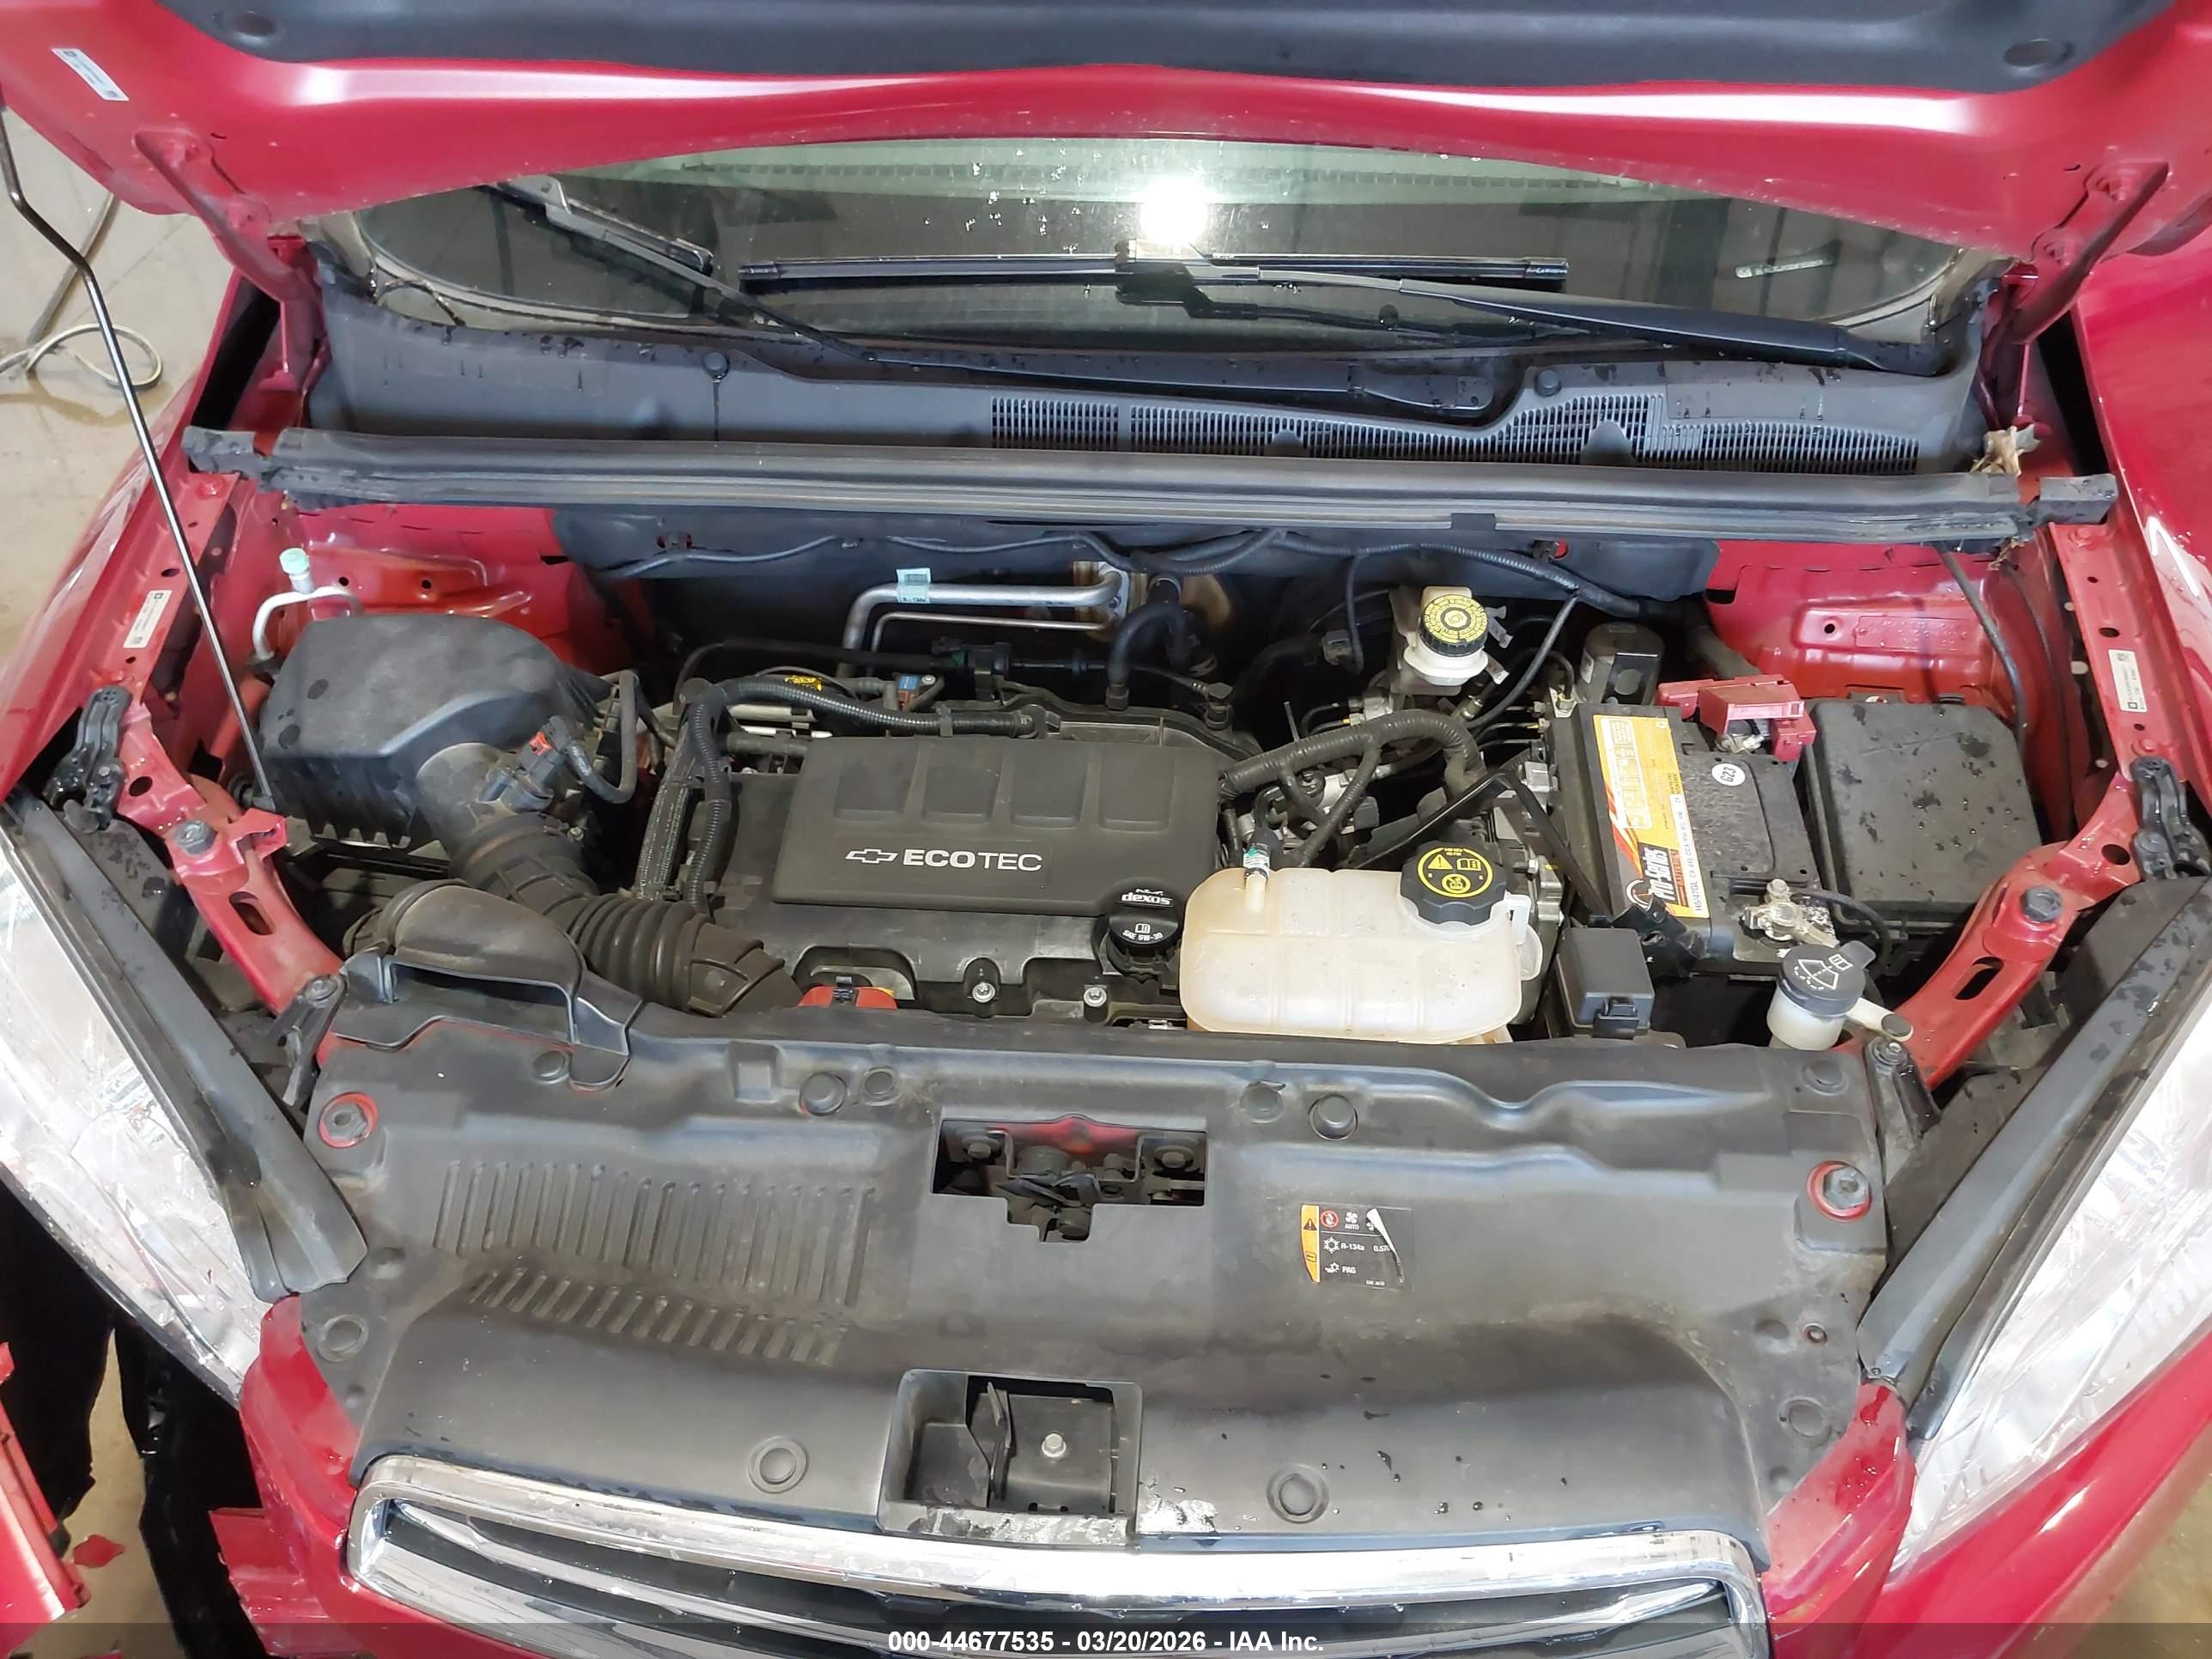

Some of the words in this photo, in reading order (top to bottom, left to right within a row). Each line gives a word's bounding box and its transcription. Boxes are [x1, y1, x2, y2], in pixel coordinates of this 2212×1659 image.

[1720, 767, 1736, 782] G23
[902, 848, 1043, 872] ECOTEC
[1642, 847, 1676, 901] Pro-Series
[1121, 892, 1174, 905] dexos
[1122, 929, 1137, 939] SAE
[1138, 932, 1164, 941] 5W-30
[1340, 1243, 1365, 1251] R-134a
[1341, 1266, 1357, 1274] PAG
